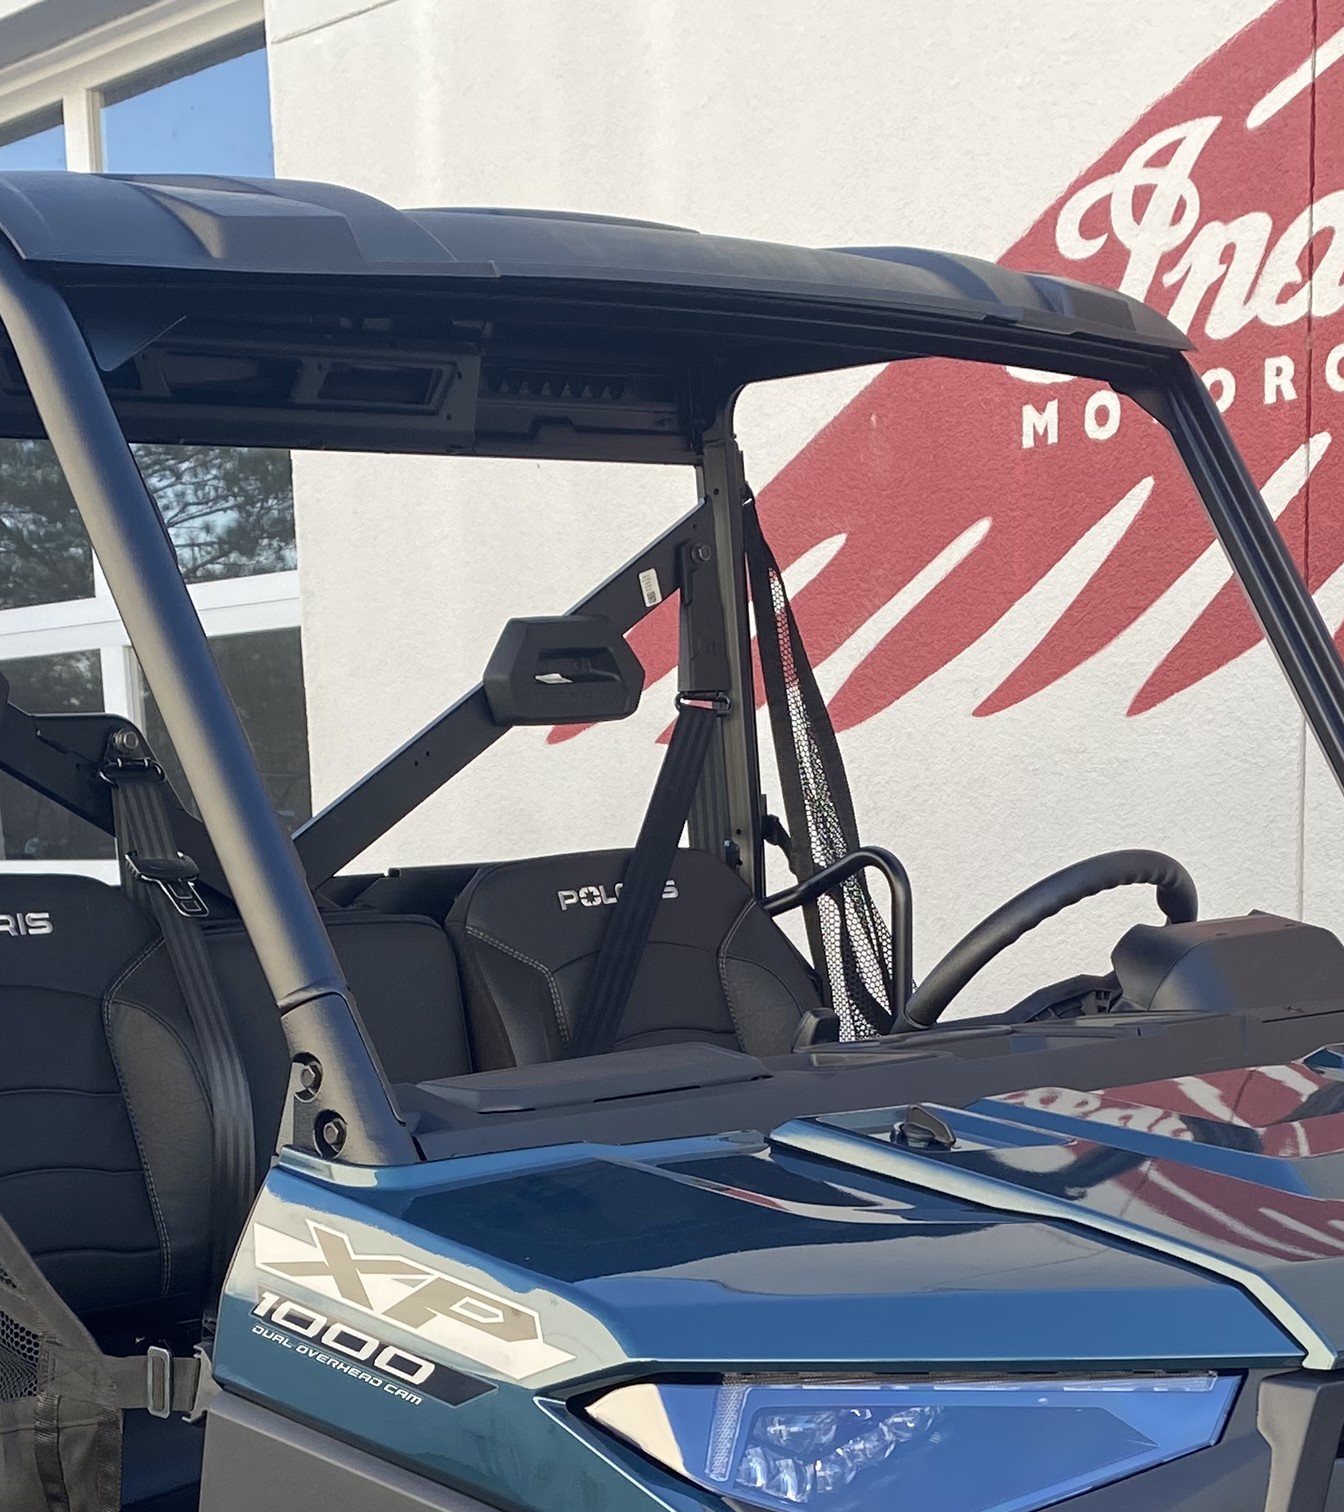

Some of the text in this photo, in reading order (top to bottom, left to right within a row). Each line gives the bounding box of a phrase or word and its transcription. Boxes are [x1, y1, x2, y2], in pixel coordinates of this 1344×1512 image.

[557, 879, 680, 911] POLS
[259, 1220, 543, 1344] XP
[251, 1325, 422, 1406] DUAL OVERHEAD CAM
[252, 1291, 436, 1386] 1000
